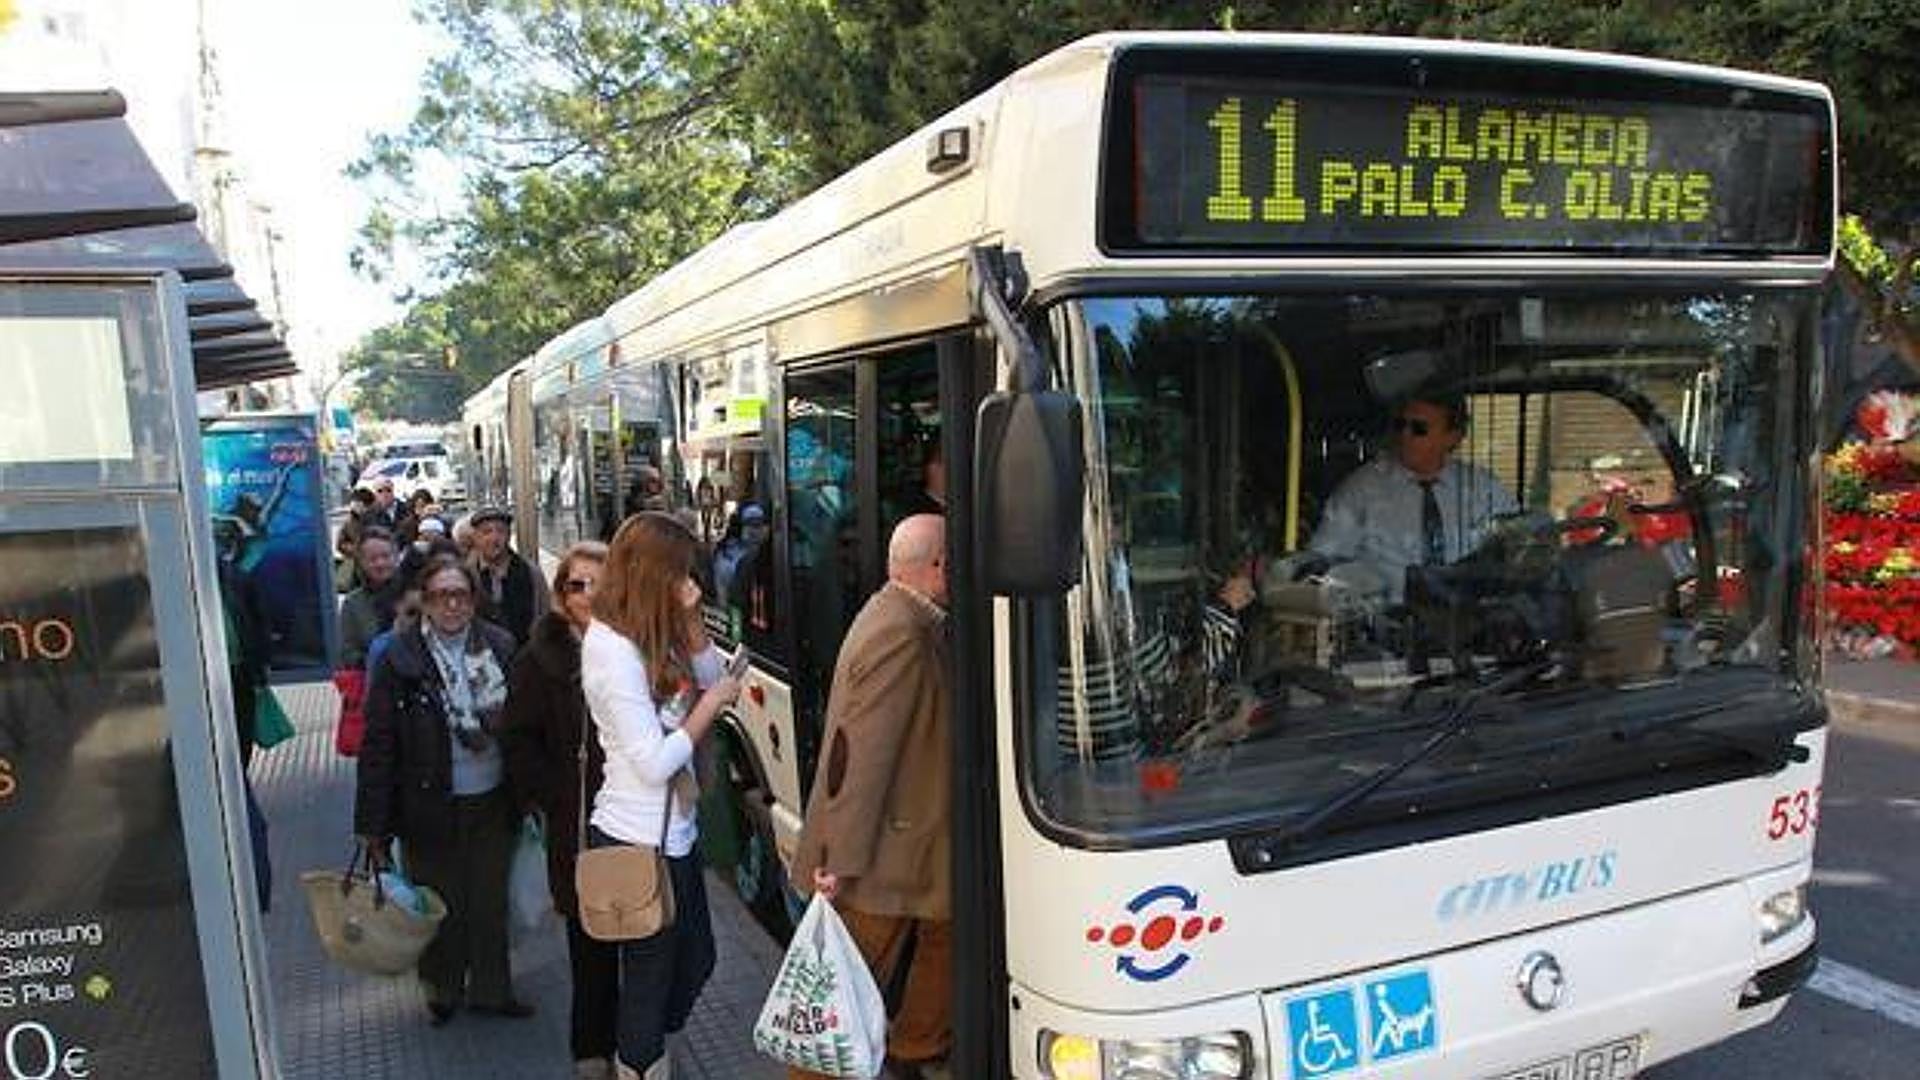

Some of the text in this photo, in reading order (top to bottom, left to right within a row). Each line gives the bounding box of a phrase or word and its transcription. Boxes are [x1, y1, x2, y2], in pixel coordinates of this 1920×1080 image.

[1208, 98, 1305, 220] 11
[1408, 106, 1649, 166] ALAMEDA
[1321, 162, 1466, 217] PALO
[21, 982, 75, 1004] Plus
